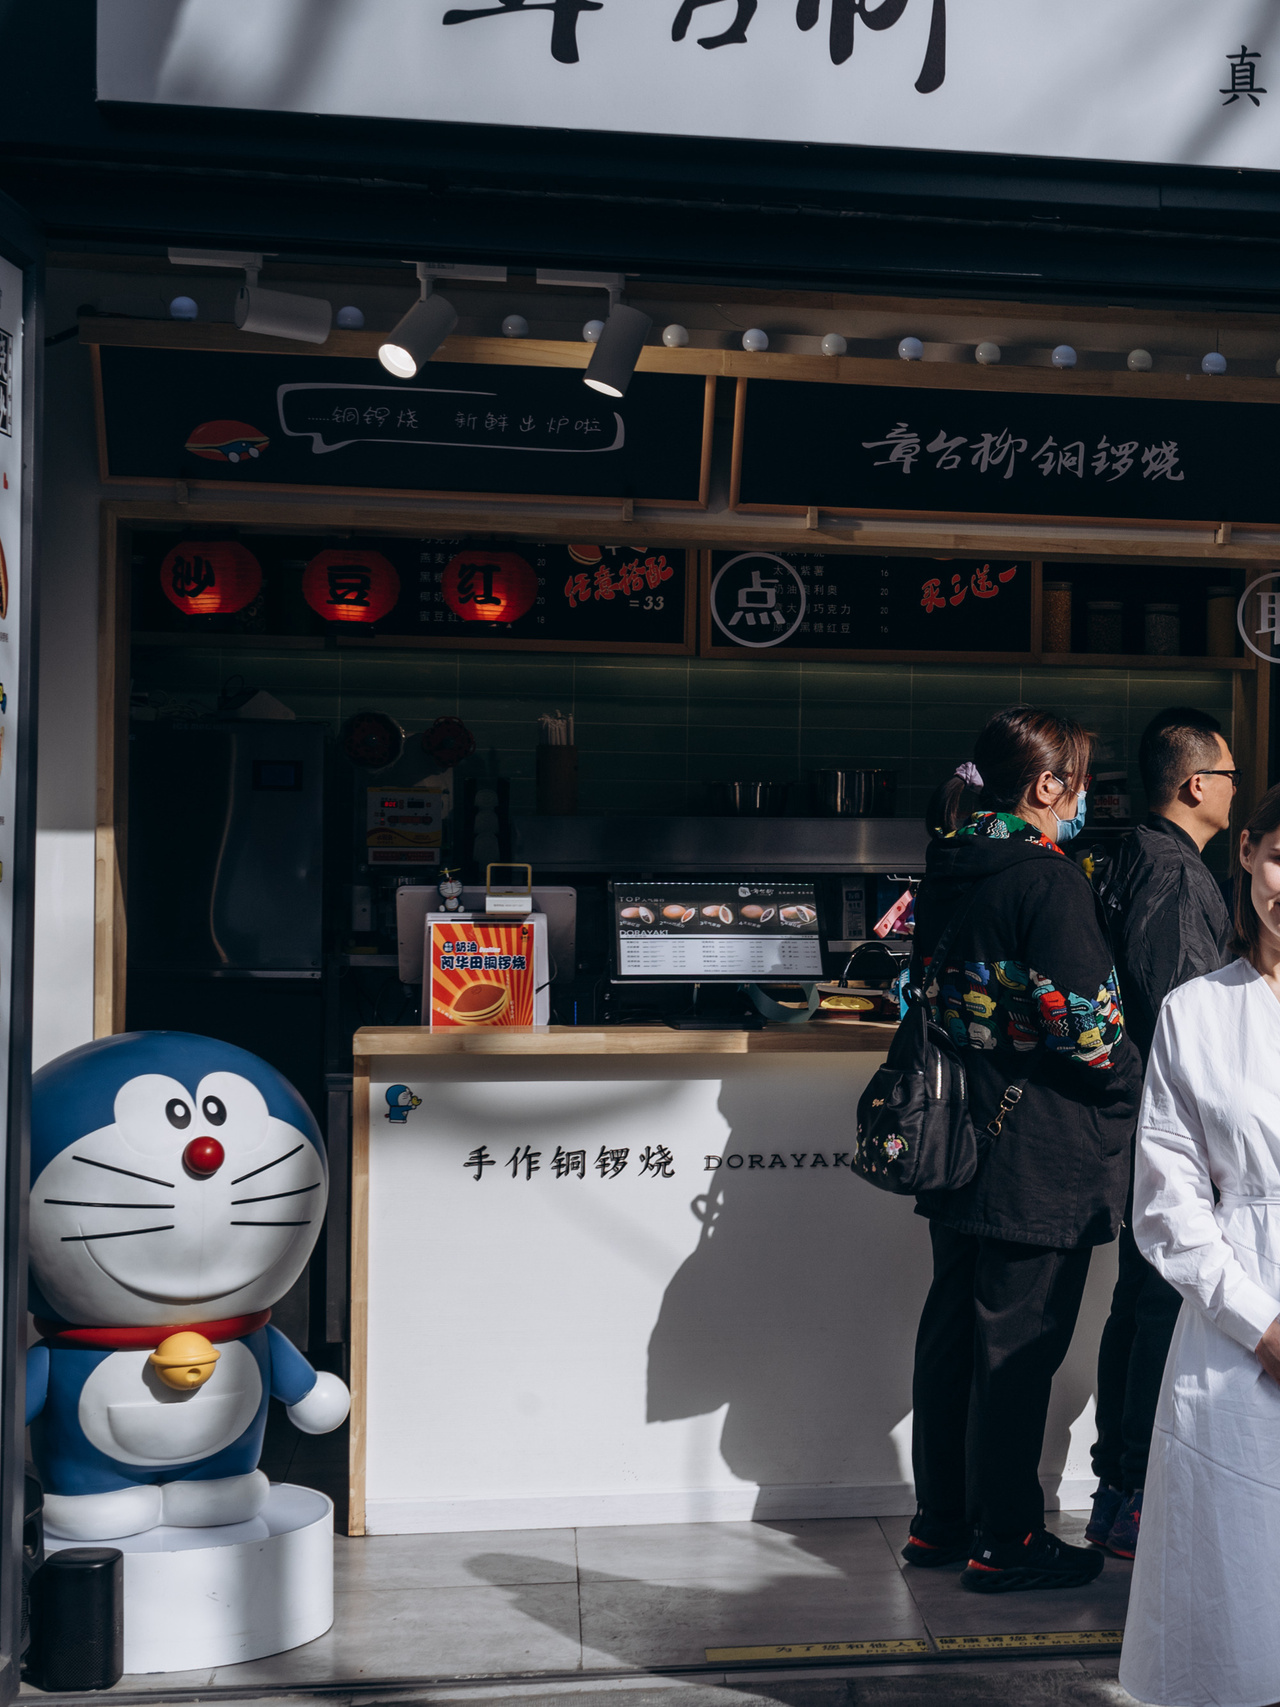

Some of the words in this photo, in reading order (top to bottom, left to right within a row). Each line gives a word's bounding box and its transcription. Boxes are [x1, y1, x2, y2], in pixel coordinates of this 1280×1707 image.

[454, 411, 602, 434] 新鲜出炉啦
[861, 422, 1185, 482] 章台柳铜锣烧
[537, 559, 546, 567] 20
[564, 555, 674, 608] 任意搭配
[881, 569, 889, 577] 16
[326, 565, 371, 606] 豆
[458, 564, 501, 606] 红
[880, 587, 889, 596] 20
[920, 564, 1018, 613] 买三送一
[537, 597, 546, 605] 20
[728, 570, 786, 626] 点
[537, 616, 546, 624] 18
[880, 606, 889, 615] 20
[880, 626, 889, 634] 16
[440, 955, 527, 971] 阿华田铜锣烧
[463, 1145, 675, 1181] 手作铜锣烧
